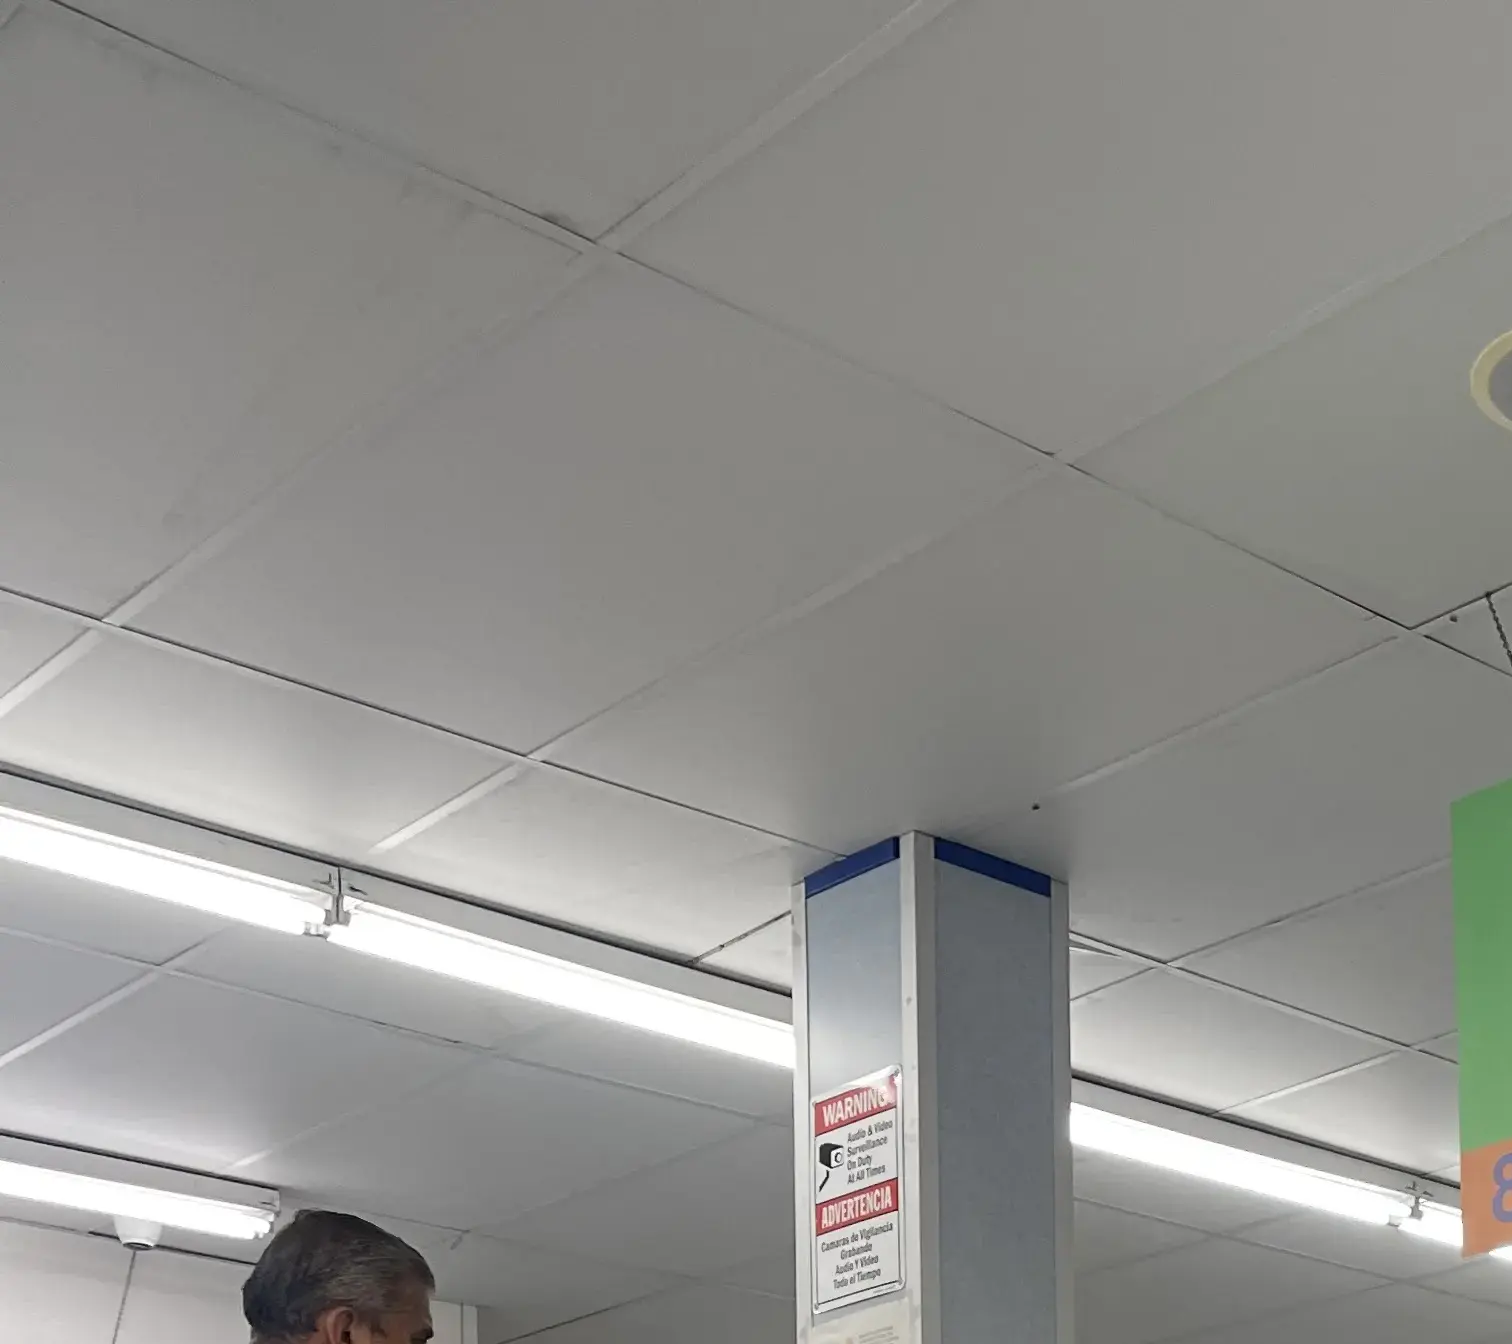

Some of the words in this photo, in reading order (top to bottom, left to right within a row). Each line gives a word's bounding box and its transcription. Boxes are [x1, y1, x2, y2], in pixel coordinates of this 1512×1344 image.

[848, 1128, 866, 1143] Audio
[867, 1124, 873, 1136] &
[874, 1120, 893, 1133] Video
[847, 1136, 888, 1157] Surveillance
[847, 1159, 856, 1171] On
[857, 1155, 873, 1168] Duty
[847, 1173, 855, 1185] At
[856, 1170, 865, 1180] All
[866, 1165, 886, 1177] Times
[821, 1186, 892, 1229] ADVERTENCIA
[821, 1236, 850, 1252] Camaras
[850, 1232, 858, 1243] de
[859, 1222, 893, 1241] Vigilancia
[840, 1242, 873, 1260] Grabando
[835, 1264, 854, 1275] Audio
[855, 1260, 859, 1269] Y
[859, 1255, 879, 1266] Video
[849, 1275, 856, 1285] el
[856, 1268, 881, 1281] Tiempo
